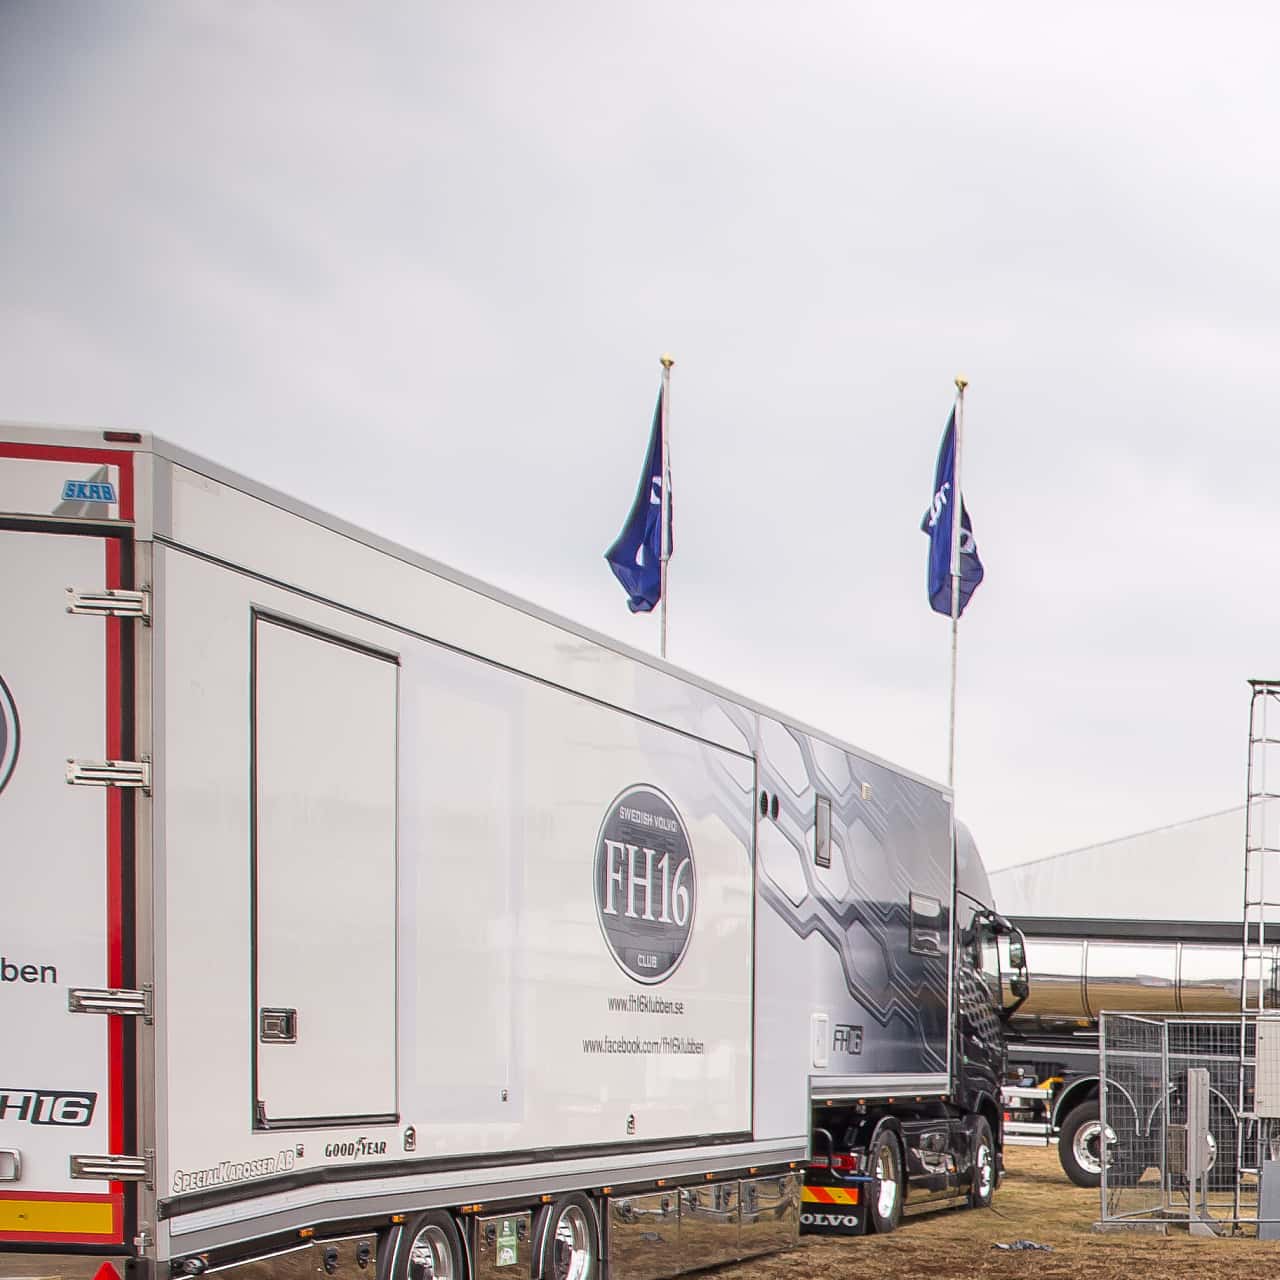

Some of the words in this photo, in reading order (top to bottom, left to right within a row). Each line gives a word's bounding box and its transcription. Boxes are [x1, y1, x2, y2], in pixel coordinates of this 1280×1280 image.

[64, 482, 113, 501] SKAB
[619, 805, 653, 827] SWEDISH
[653, 814, 678, 833] VOLVO
[603, 838, 690, 927] FH16
[637, 953, 658, 969] CLUB
[607, 994, 684, 1014] www.fh16klubben.se
[274, 1149, 295, 1172] AB
